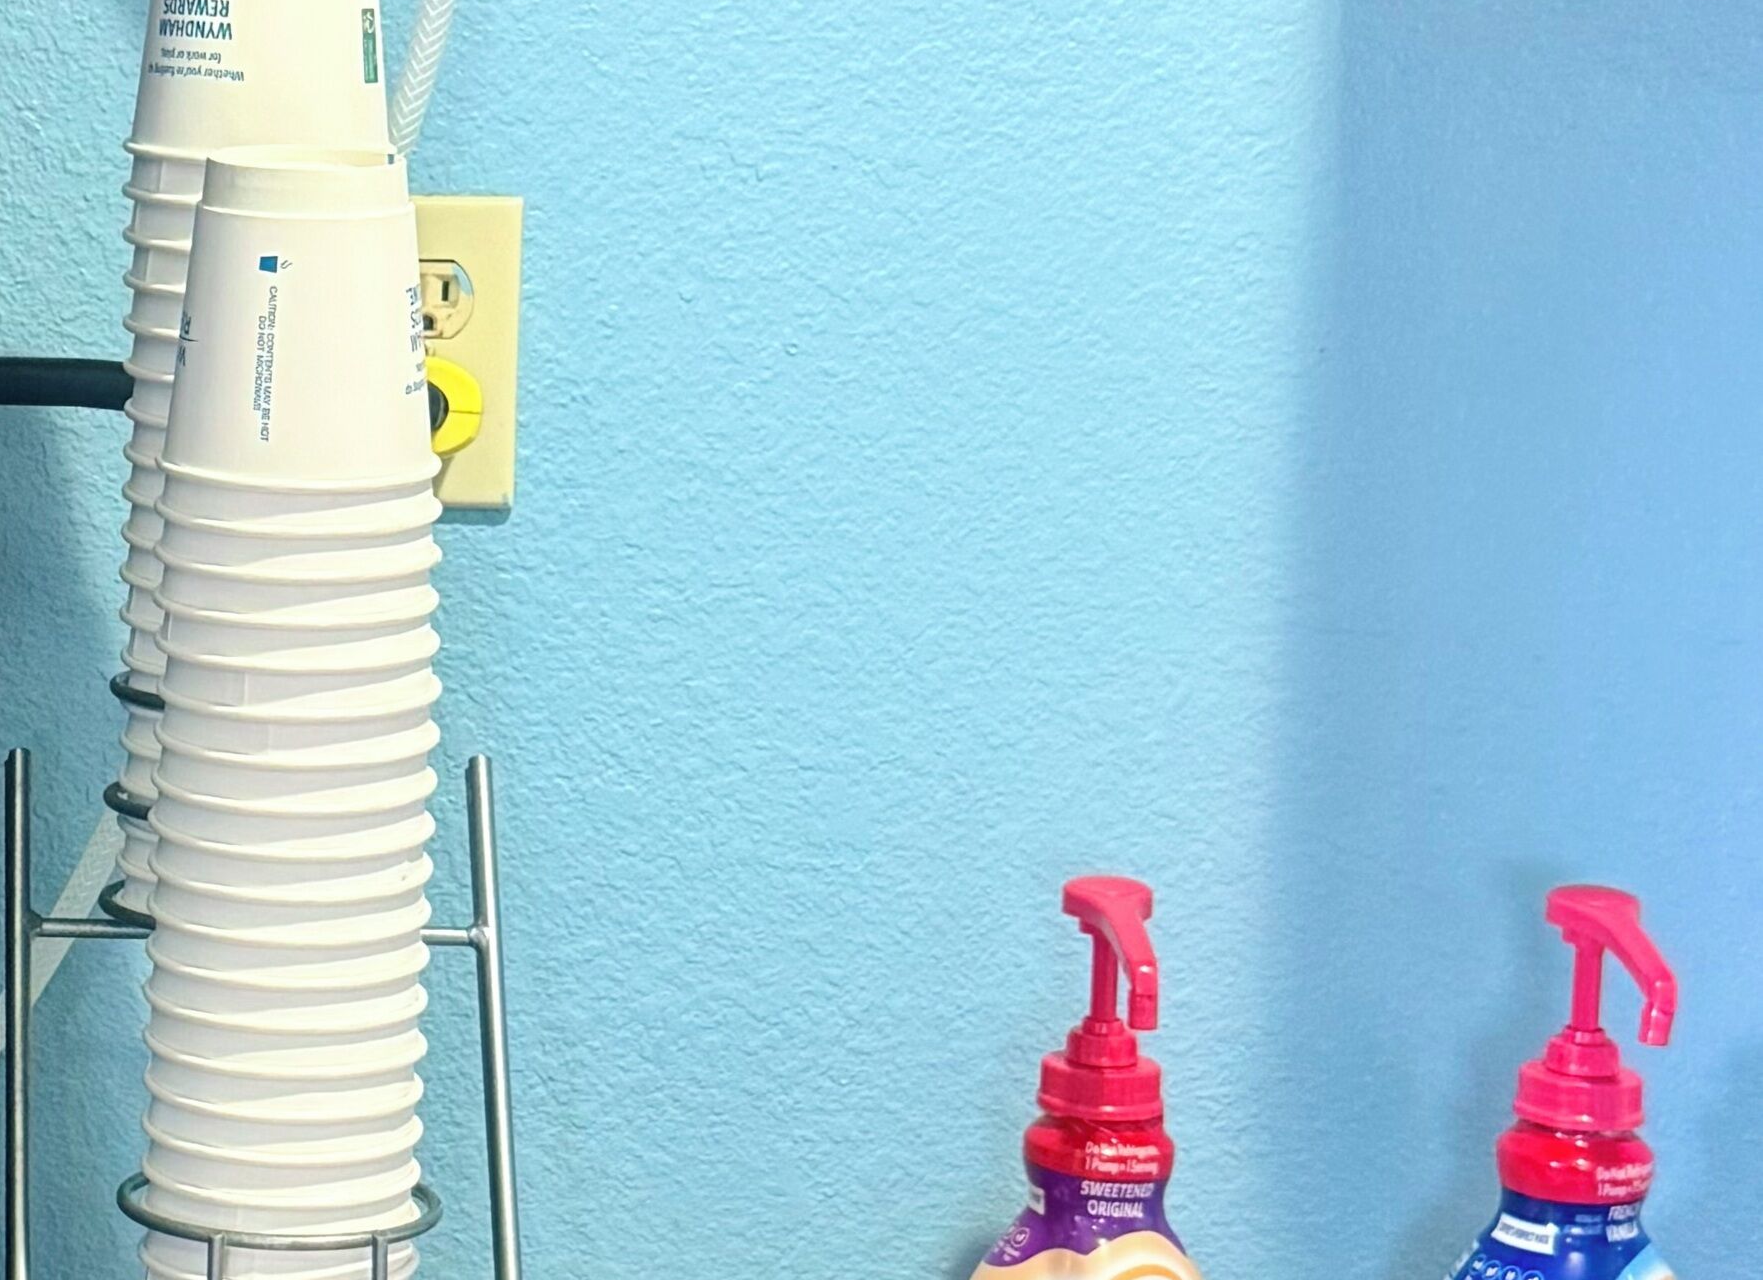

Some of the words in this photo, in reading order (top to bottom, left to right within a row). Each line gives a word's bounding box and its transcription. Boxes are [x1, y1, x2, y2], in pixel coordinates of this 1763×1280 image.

[159, 19, 232, 40] WYNDHAM
[257, 315, 267, 331] DO
[256, 332, 265, 352] NOT
[1080, 1180, 1155, 1198] SWEETENED
[1087, 1199, 1144, 1218] ORIGINAL
